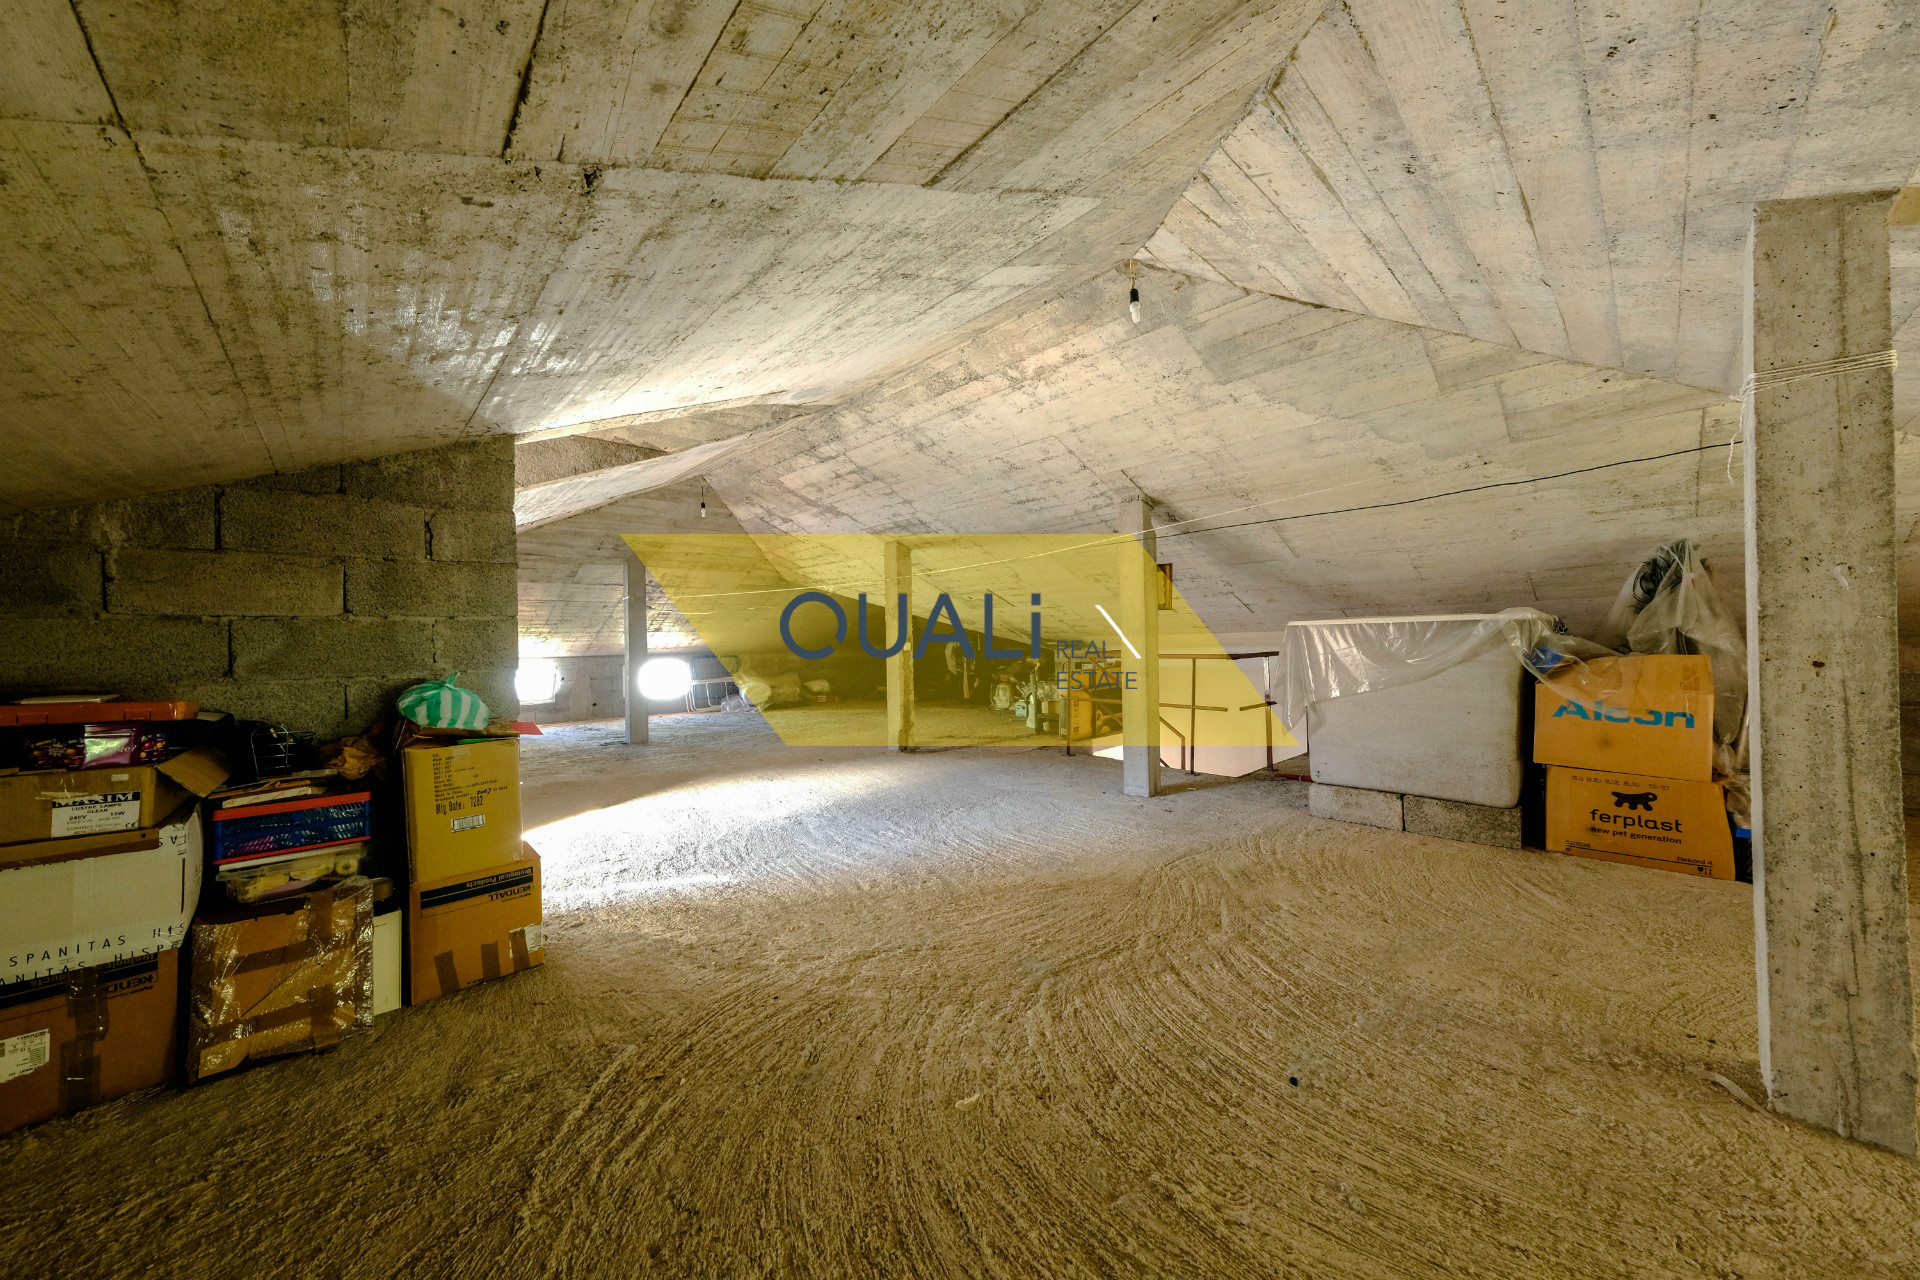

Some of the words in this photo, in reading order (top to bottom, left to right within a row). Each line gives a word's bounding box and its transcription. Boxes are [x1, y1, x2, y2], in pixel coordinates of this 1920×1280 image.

[1590, 809, 1683, 833] ferplast
[1591, 826, 1610, 834] new
[1612, 829, 1628, 837] pet
[1630, 832, 1682, 844] generation
[1677, 856, 1706, 865] Rekord
[465, 875, 497, 888] Products
[498, 867, 532, 881] Urological
[487, 884, 532, 901] KENDALL
[9, 935, 127, 968] SPANITAS
